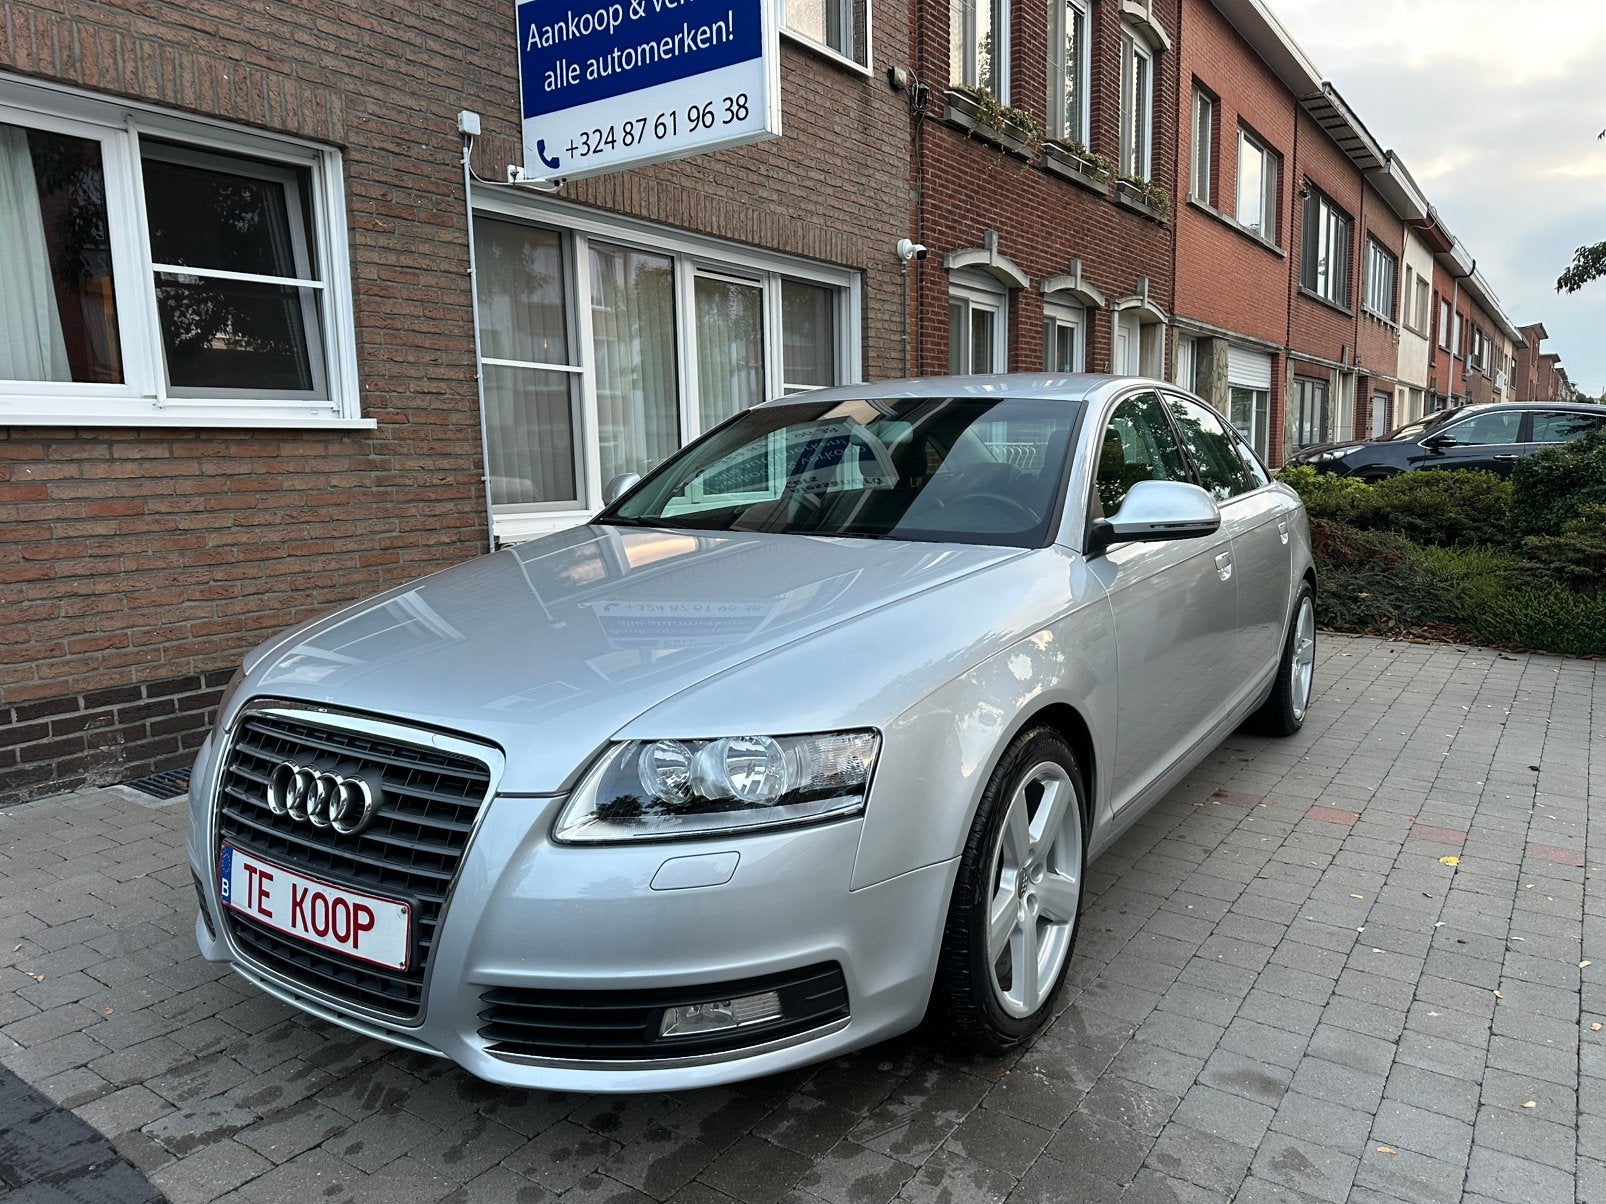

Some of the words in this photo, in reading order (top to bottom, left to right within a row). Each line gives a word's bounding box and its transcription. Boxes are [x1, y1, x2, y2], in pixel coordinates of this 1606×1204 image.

[527, 3, 623, 51] Aankoop
[629, 0, 646, 20] &
[544, 60, 580, 92] alle
[586, 10, 735, 80] automerken!
[565, 125, 617, 159] +324
[622, 117, 648, 147] 87
[654, 110, 677, 140] 61
[687, 101, 715, 132] 96
[722, 93, 749, 125] 38
[220, 877, 230, 898] B
[244, 863, 274, 919] TE
[291, 882, 375, 950] KOOP
